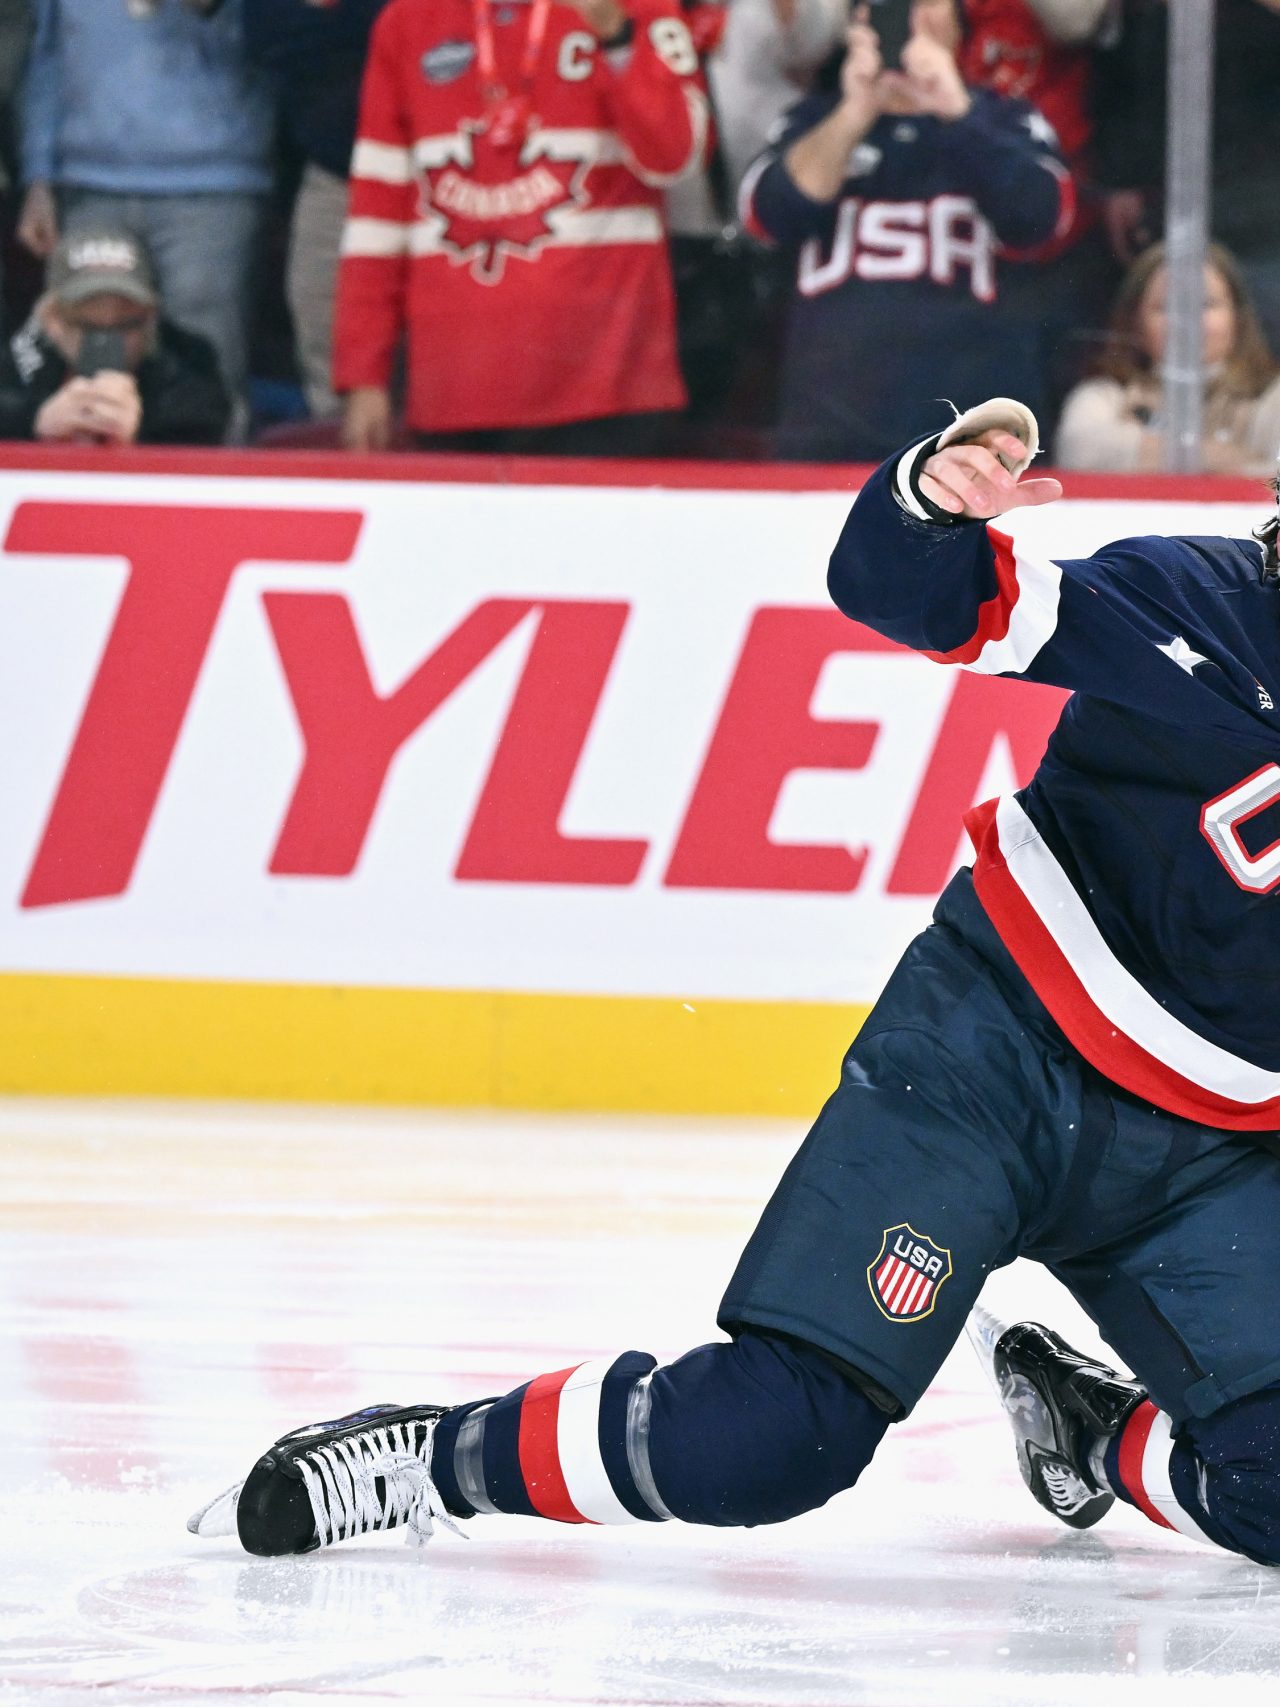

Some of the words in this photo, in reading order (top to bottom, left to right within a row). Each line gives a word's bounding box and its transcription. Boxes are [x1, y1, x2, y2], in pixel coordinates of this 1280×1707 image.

[557, 31, 597, 82] C
[797, 194, 999, 304] USA
[893, 1234, 943, 1279] USA
